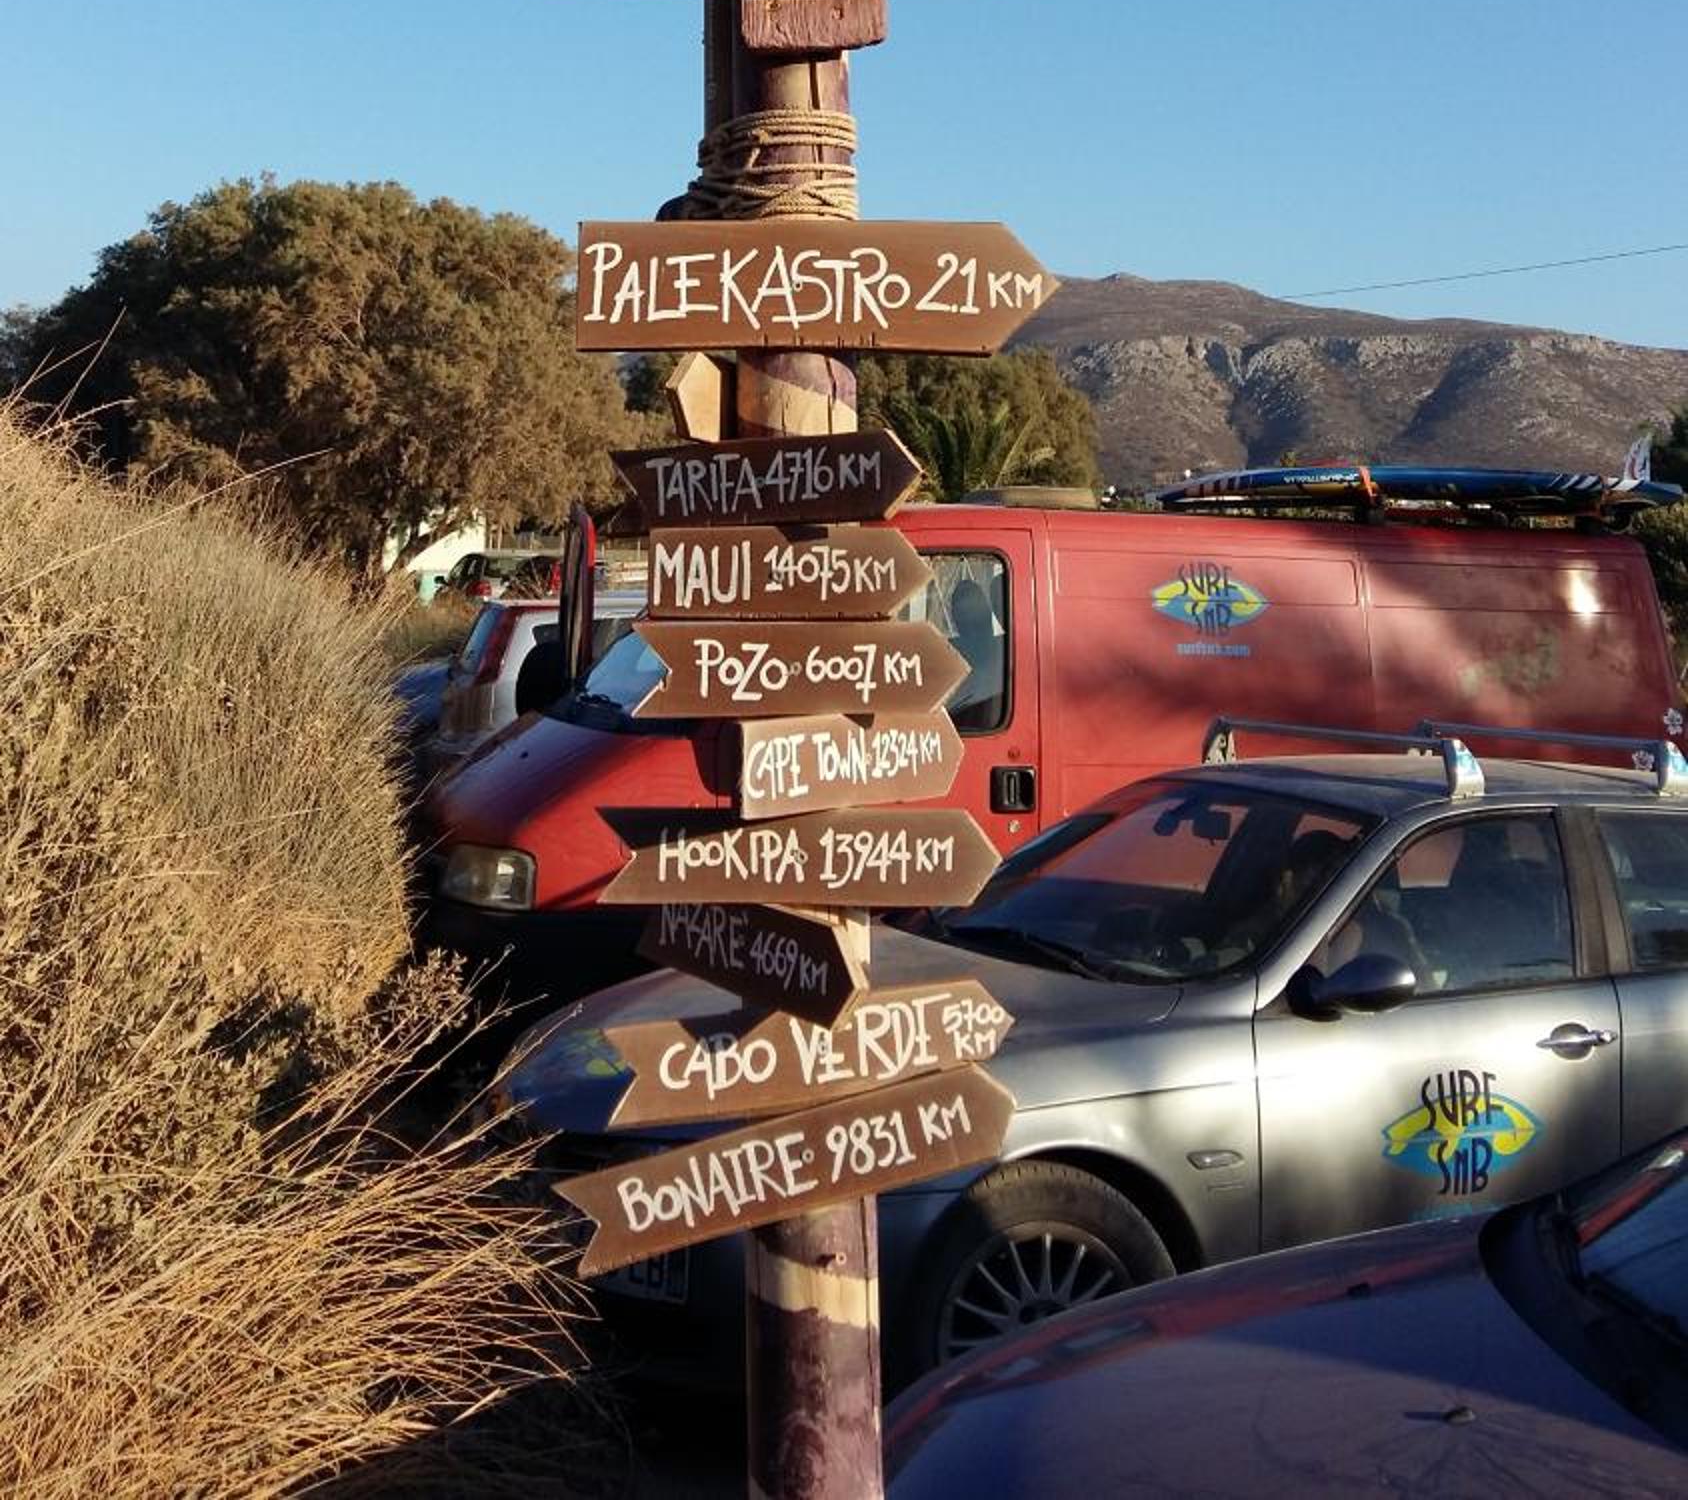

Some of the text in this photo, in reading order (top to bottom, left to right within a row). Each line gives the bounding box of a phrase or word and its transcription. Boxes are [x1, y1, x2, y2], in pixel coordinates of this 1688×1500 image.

[583, 242, 911, 330] PALEKASTRO
[987, 271, 1044, 309] KM
[645, 446, 881, 517] TARIFA 4716 KM
[652, 540, 897, 609] MAUI 14075 KM
[1178, 562, 1238, 597] SURF
[694, 638, 923, 703] POZO 6007 KM
[812, 727, 868, 785] TOWN
[919, 730, 943, 765] KM
[657, 827, 955, 889] HOOKIPA 13944 KM
[750, 931, 799, 991] 4669
[800, 953, 830, 997] KM
[659, 1033, 778, 1101] CABO
[954, 1030, 997, 1061] KM
[1421, 1069, 1505, 1132] SURF
[616, 1094, 972, 1233] BONAIRE 9831 KM
